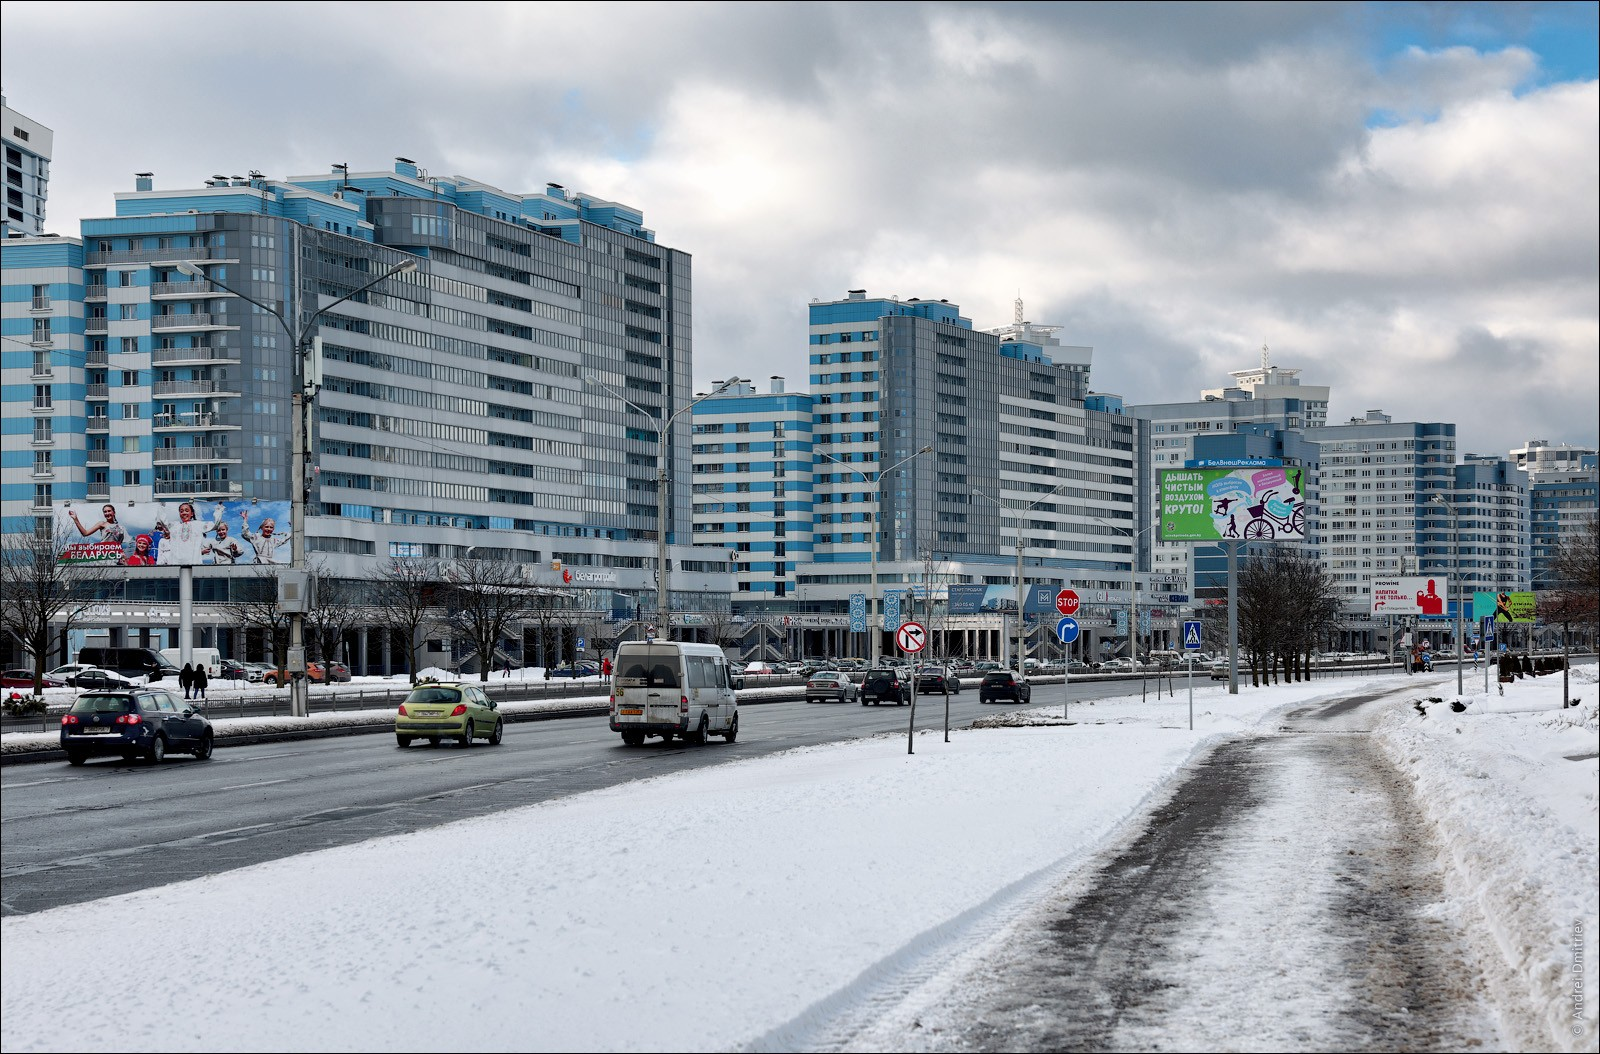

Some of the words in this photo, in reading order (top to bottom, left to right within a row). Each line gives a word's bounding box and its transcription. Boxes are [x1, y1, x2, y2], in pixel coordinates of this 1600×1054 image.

[1165, 473, 1203, 482] ДЫШАТЬ
[1165, 483, 1203, 491] ЧИСТЫМ
[1165, 494, 1204, 502] ВОЗДУХОМ
[1165, 504, 1204, 514] КРУТО!
[79, 543, 122, 551] выбираем
[71, 551, 122, 559] БЕЛАРУСЬ
[1057, 598, 1078, 606] STOP
[616, 687, 624, 697] 56
